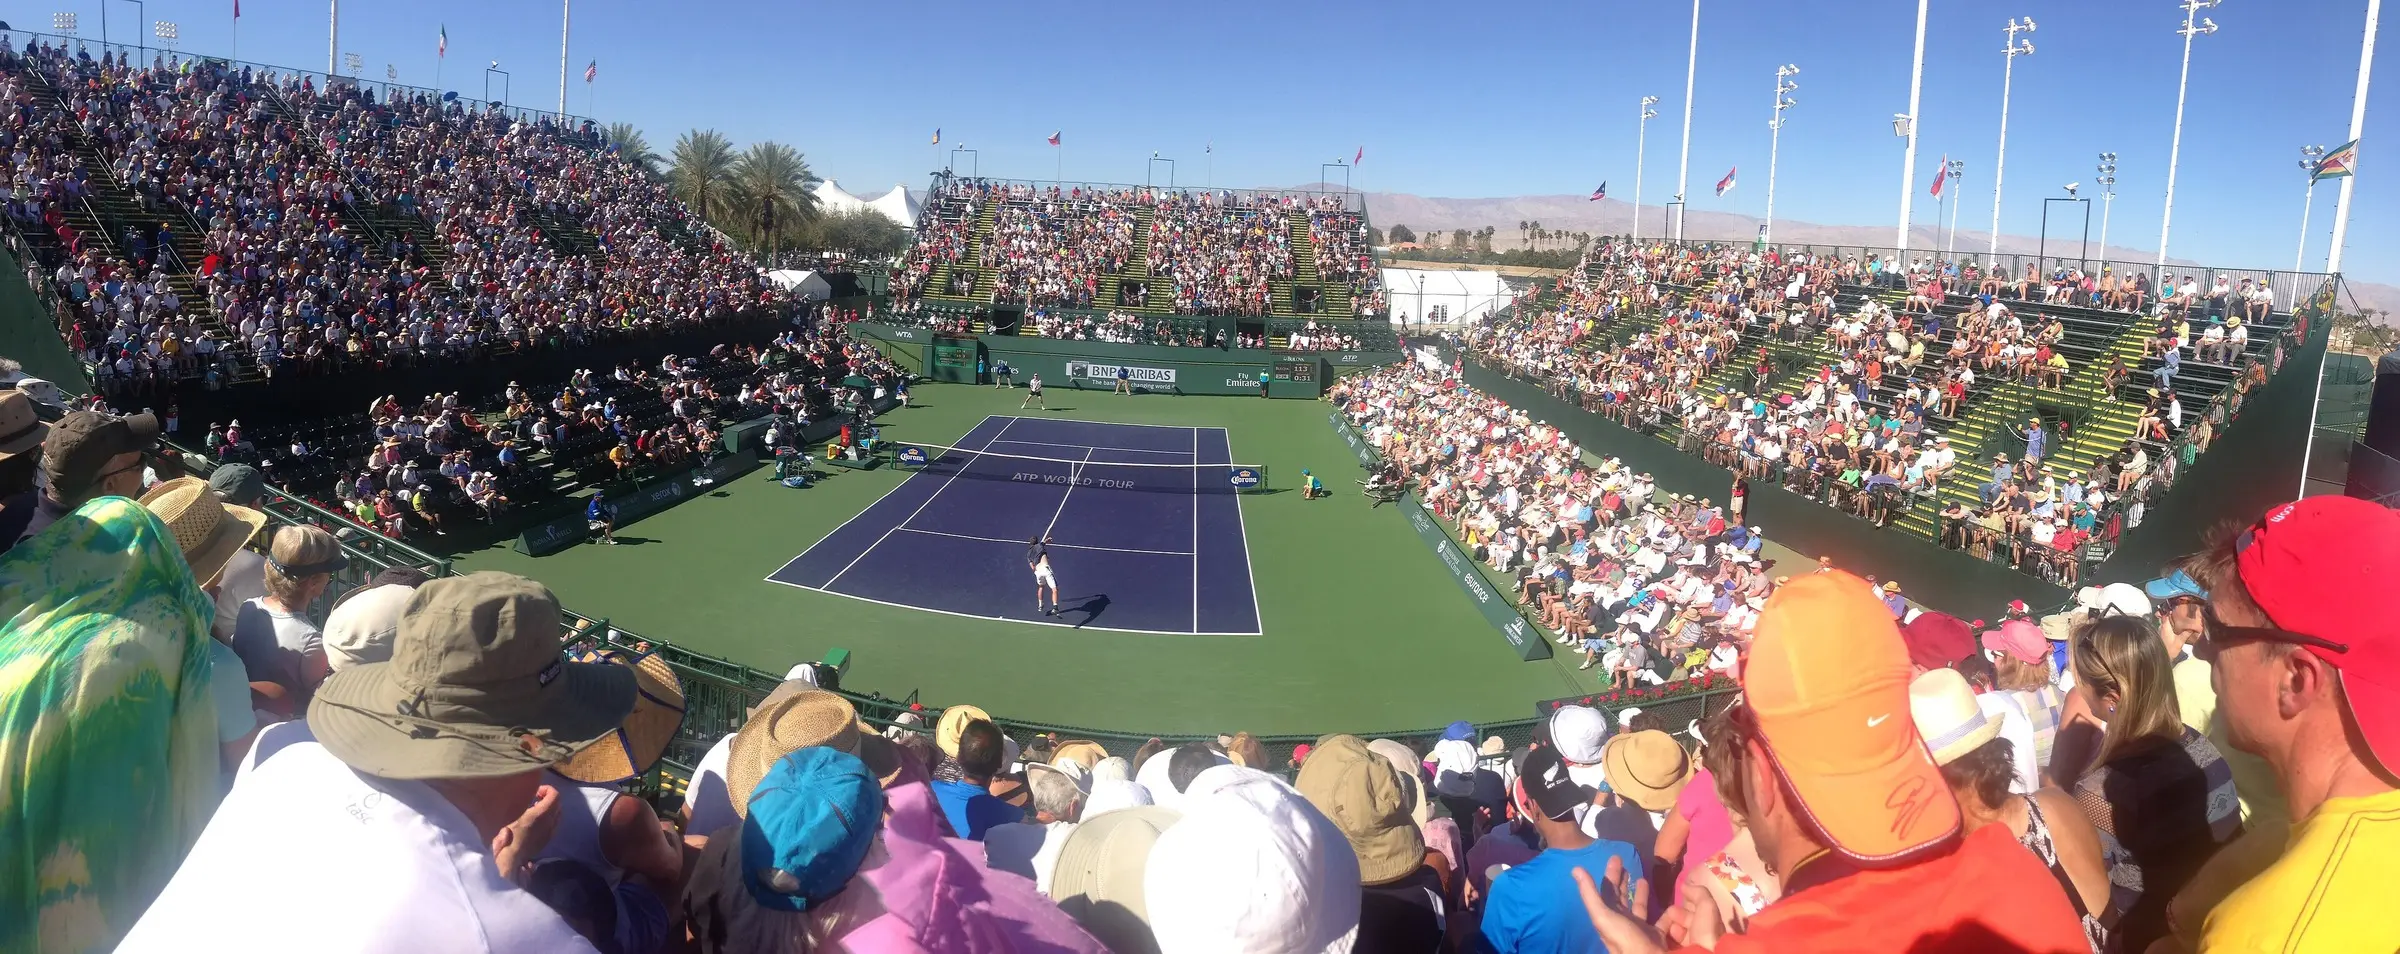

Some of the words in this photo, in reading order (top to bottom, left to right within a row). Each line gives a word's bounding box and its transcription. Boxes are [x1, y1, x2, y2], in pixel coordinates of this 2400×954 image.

[895, 331, 913, 339] WTA
[1092, 366, 1117, 377] BNP
[1238, 372, 1249, 380] Fly
[1131, 382, 1154, 390] changing
[1226, 379, 1260, 387] Emirates
[900, 452, 925, 462] Corona
[1012, 472, 1039, 482] ATP
[1099, 478, 1135, 489] TOUR
[1231, 475, 1257, 485] Corona
[650, 488, 671, 501] xerox
[1464, 573, 1489, 604] esurance
